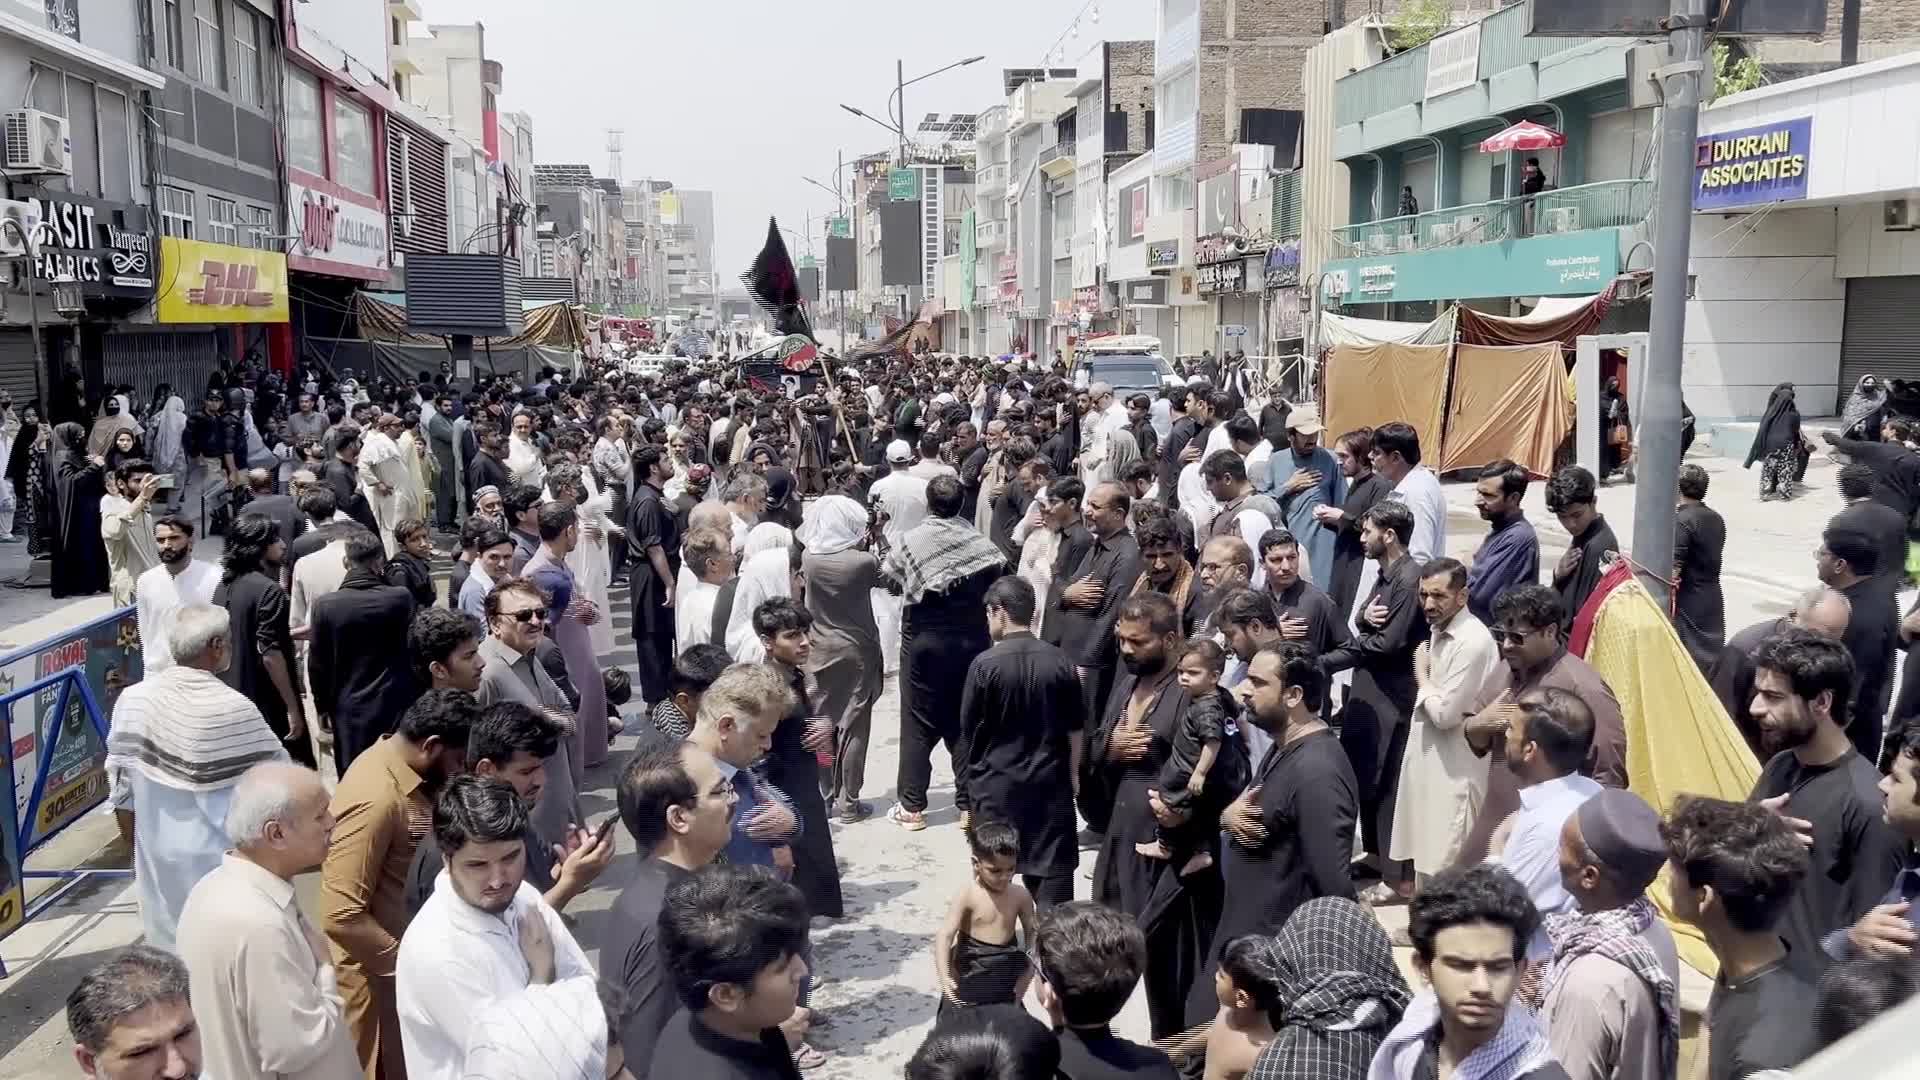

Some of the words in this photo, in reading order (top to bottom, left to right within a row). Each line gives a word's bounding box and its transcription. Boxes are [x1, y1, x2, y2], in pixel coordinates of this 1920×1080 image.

[1713, 130, 1790, 163] DURRANI
[1700, 154, 1806, 189] ASSOCIATES
[29, 197, 95, 250] BASIT
[34, 253, 100, 282] FABRICS
[192, 259, 272, 306] DHL
[45, 796, 64, 823] 30
